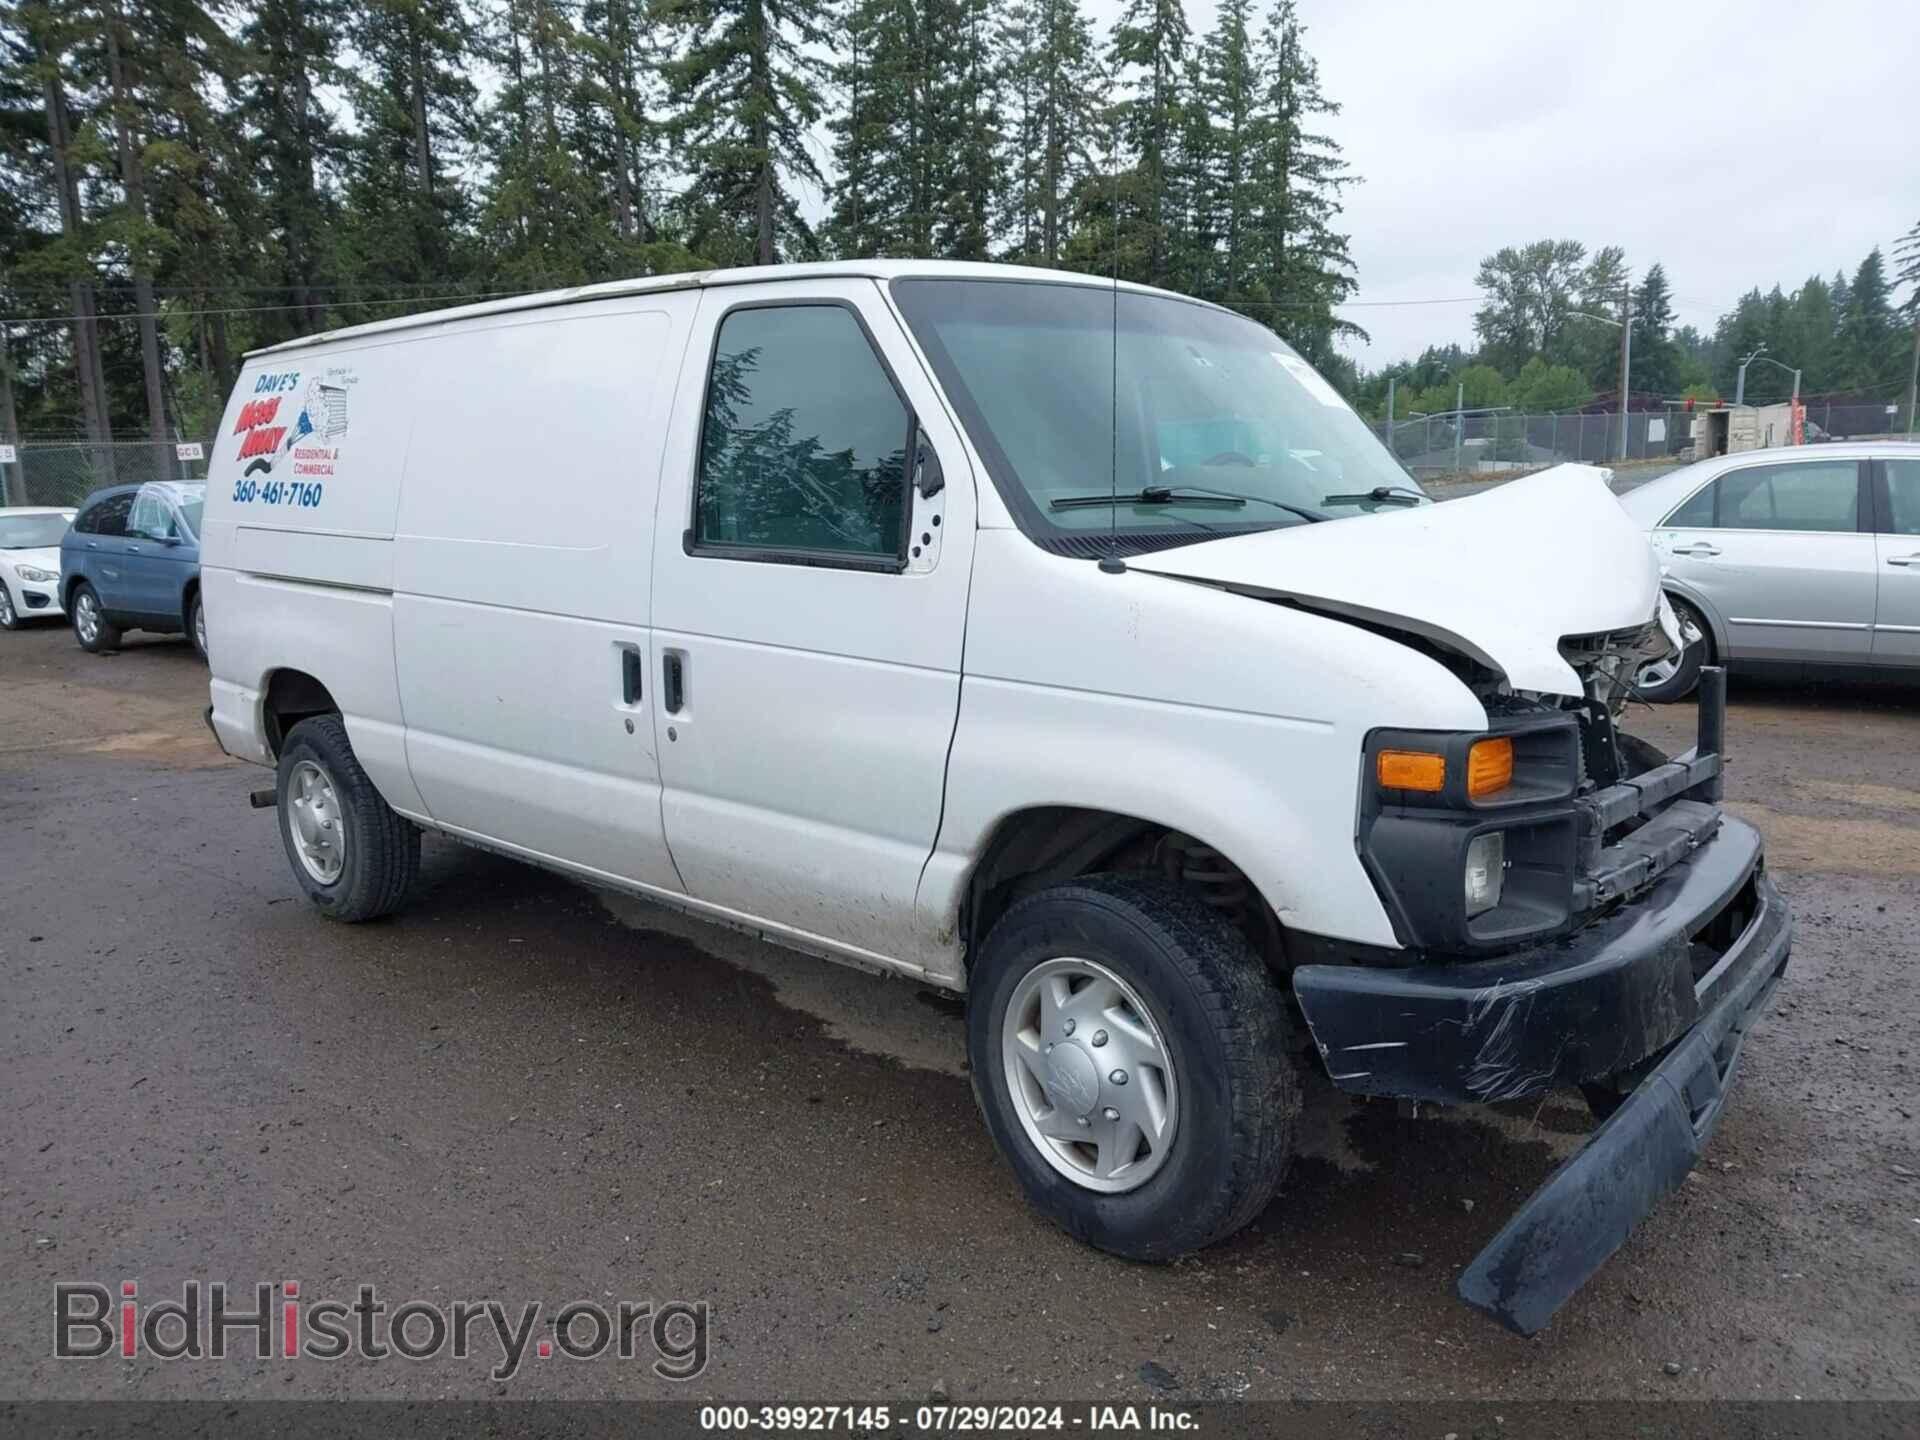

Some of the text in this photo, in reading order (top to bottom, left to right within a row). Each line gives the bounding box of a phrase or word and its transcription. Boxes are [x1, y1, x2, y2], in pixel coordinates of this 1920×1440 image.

[255, 373, 300, 393] DAVE'S
[294, 448, 331, 460] RESIDENTIAL
[294, 463, 334, 475] COMMERCIAL
